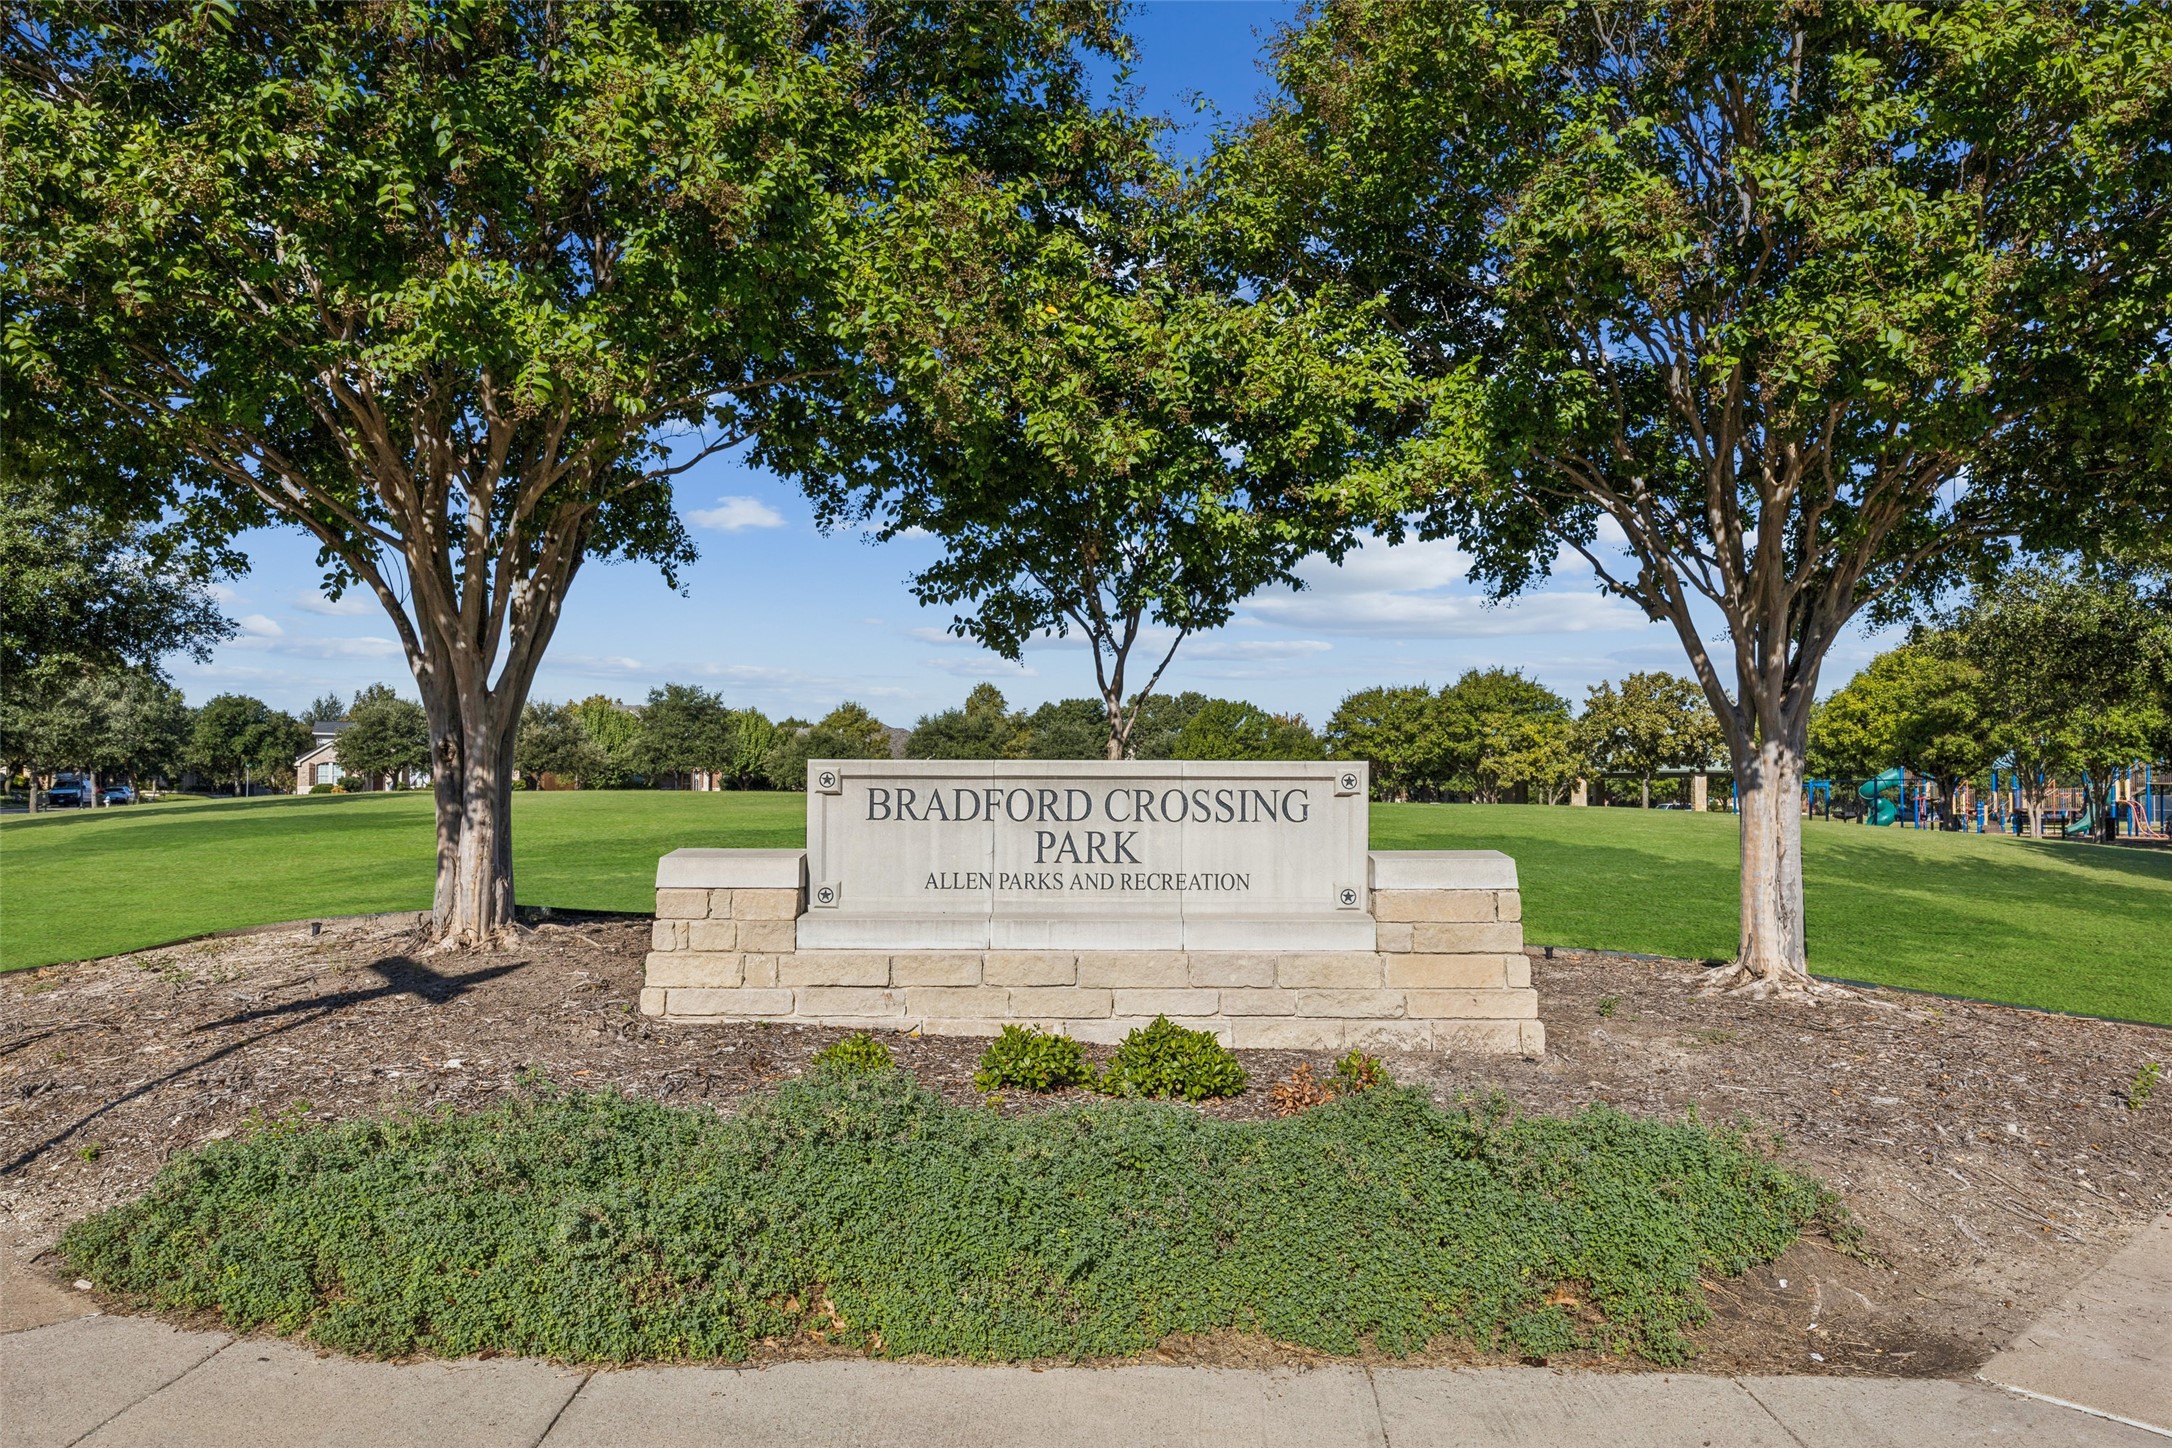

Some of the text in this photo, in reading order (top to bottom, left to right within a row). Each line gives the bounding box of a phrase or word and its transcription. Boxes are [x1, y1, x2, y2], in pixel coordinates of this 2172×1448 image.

[865, 787, 1309, 823] BRADFORD CROSSING
[1034, 830, 1142, 864] PARK
[925, 872, 1250, 891] ALLEN PARKS AND RECREATION
